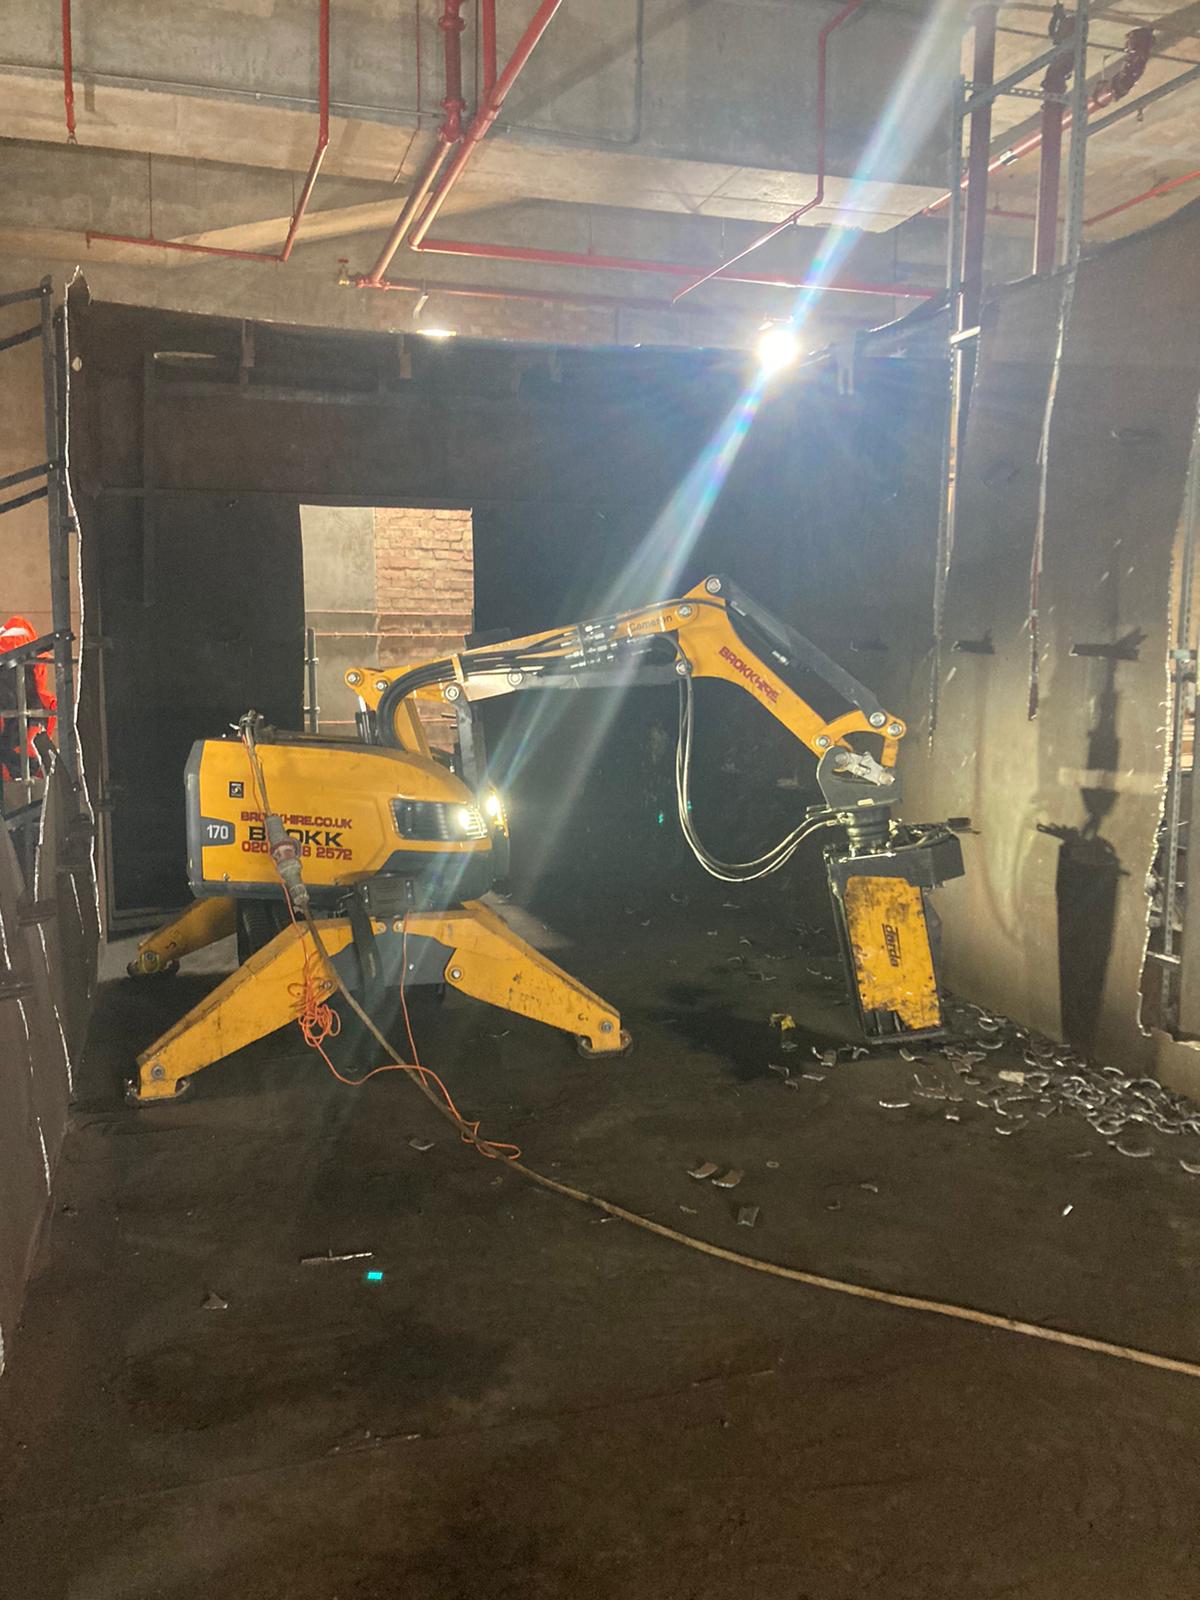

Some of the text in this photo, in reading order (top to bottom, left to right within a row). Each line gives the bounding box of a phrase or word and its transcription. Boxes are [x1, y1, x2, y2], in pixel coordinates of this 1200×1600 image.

[240, 811, 353, 829] BROHIRE.CO.UK
[206, 824, 229, 840] 170
[248, 826, 343, 847] BOKK
